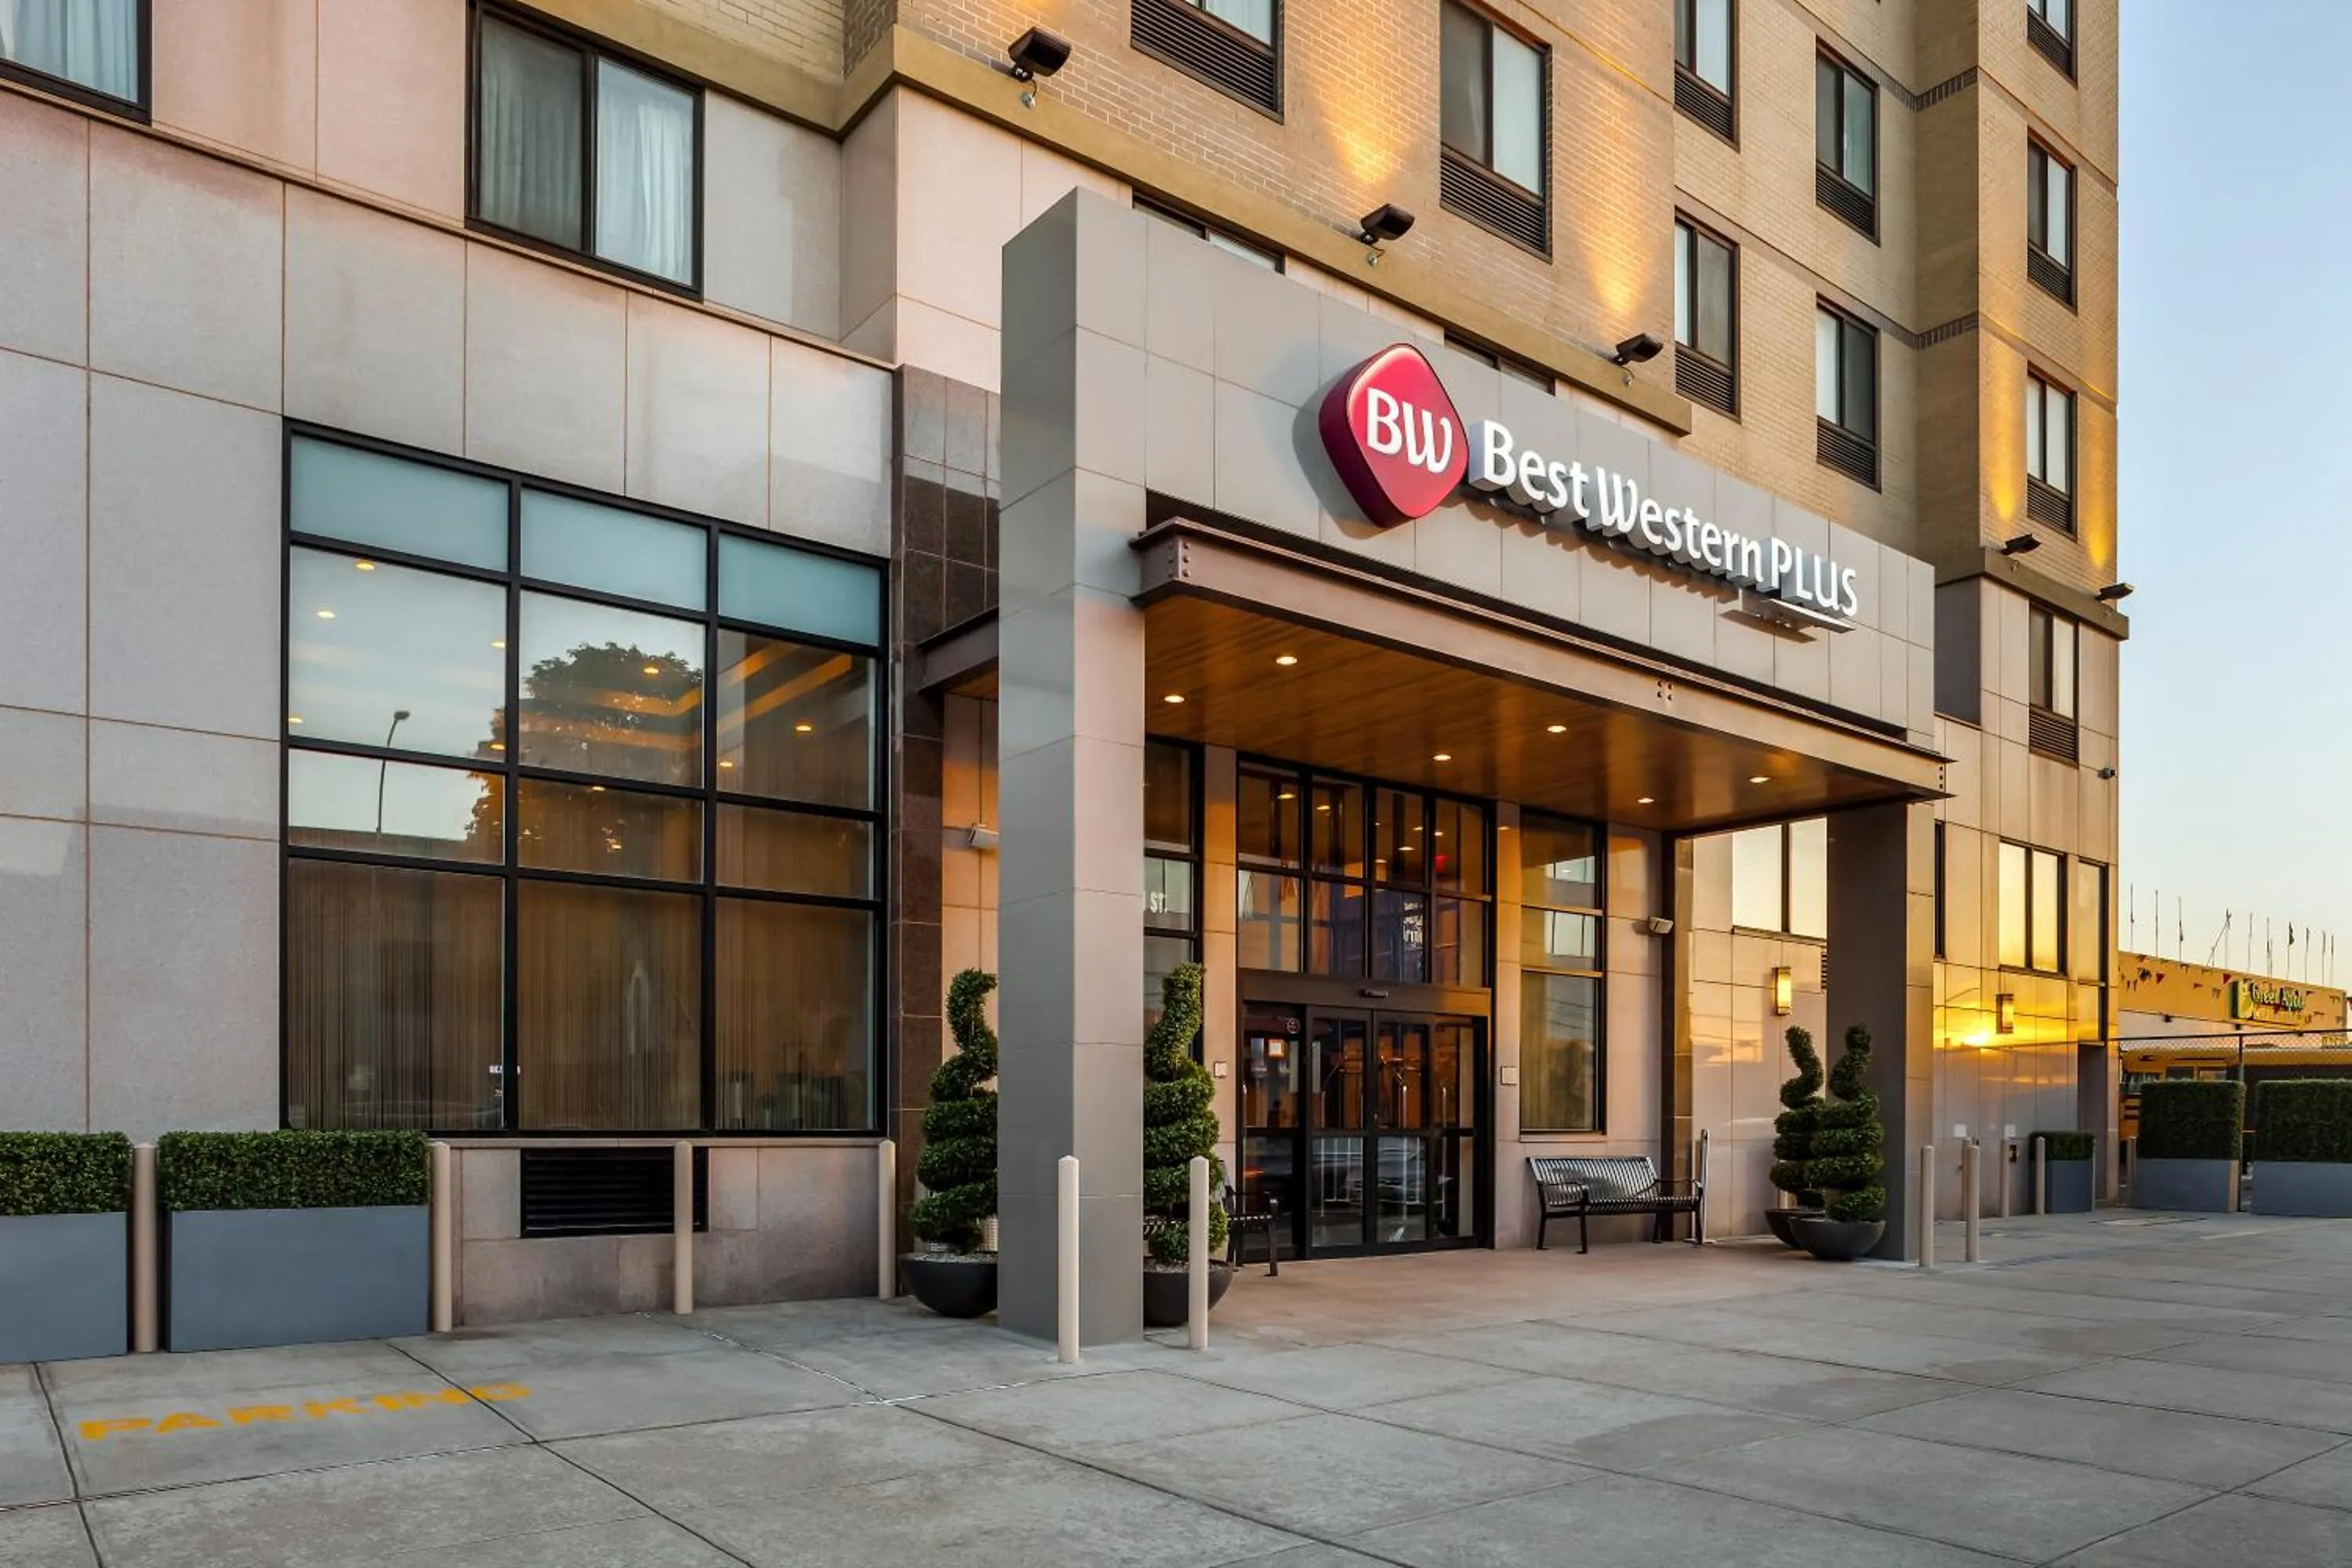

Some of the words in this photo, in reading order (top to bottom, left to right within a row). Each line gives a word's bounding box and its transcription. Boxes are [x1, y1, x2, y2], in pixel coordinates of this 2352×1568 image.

[1367, 387, 1453, 474] BW
[1483, 419, 1591, 518] Best
[1595, 465, 1764, 583] Western
[1770, 536, 1858, 617] PLUS
[78, 1381, 532, 1441] PARKING
